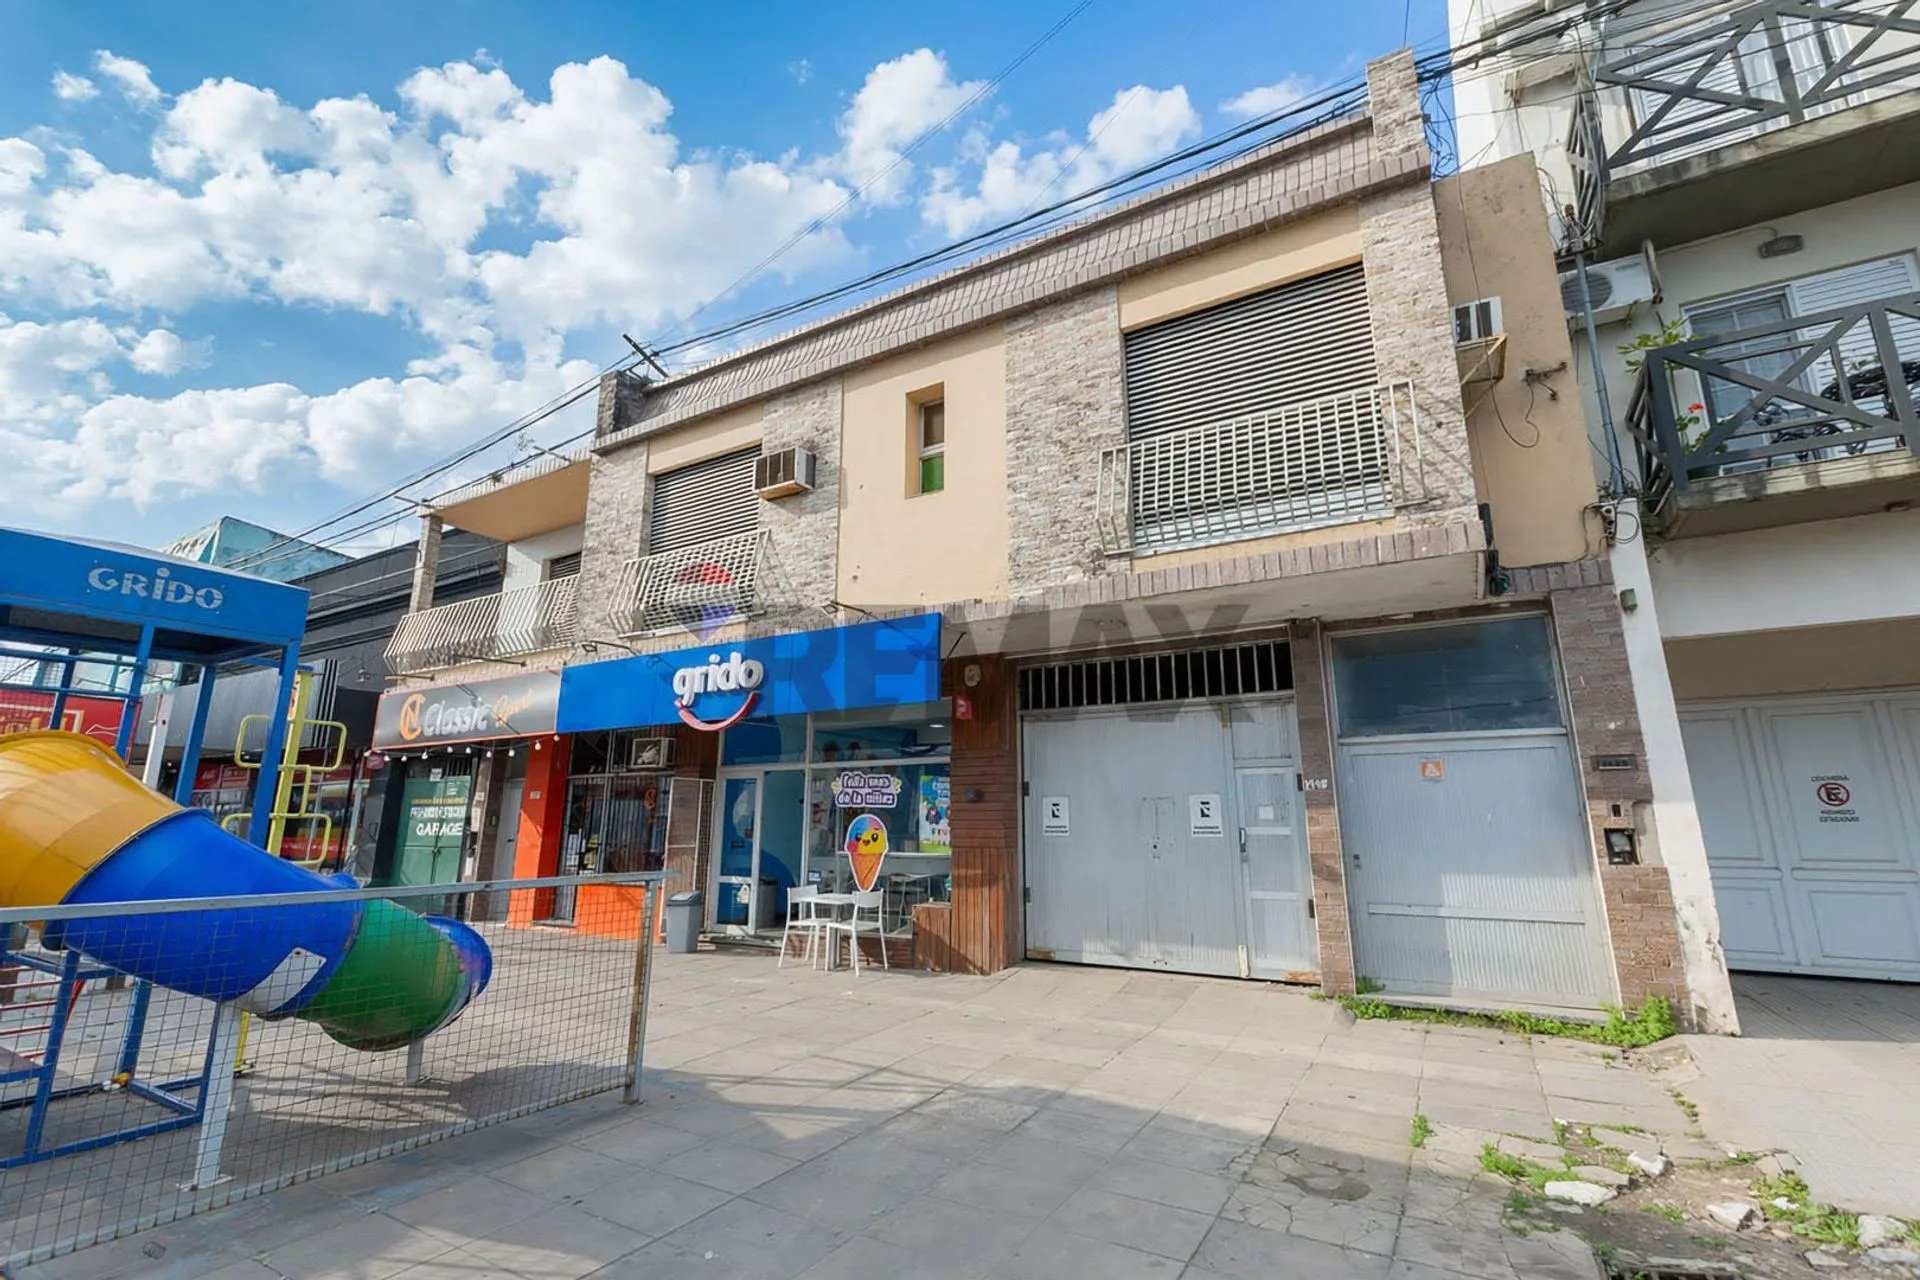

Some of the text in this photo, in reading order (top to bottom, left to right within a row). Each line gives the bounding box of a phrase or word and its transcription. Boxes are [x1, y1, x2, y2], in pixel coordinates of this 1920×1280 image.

[673, 651, 764, 707] grido
[423, 700, 491, 737] Classic
[416, 821, 463, 836] GARAGE
